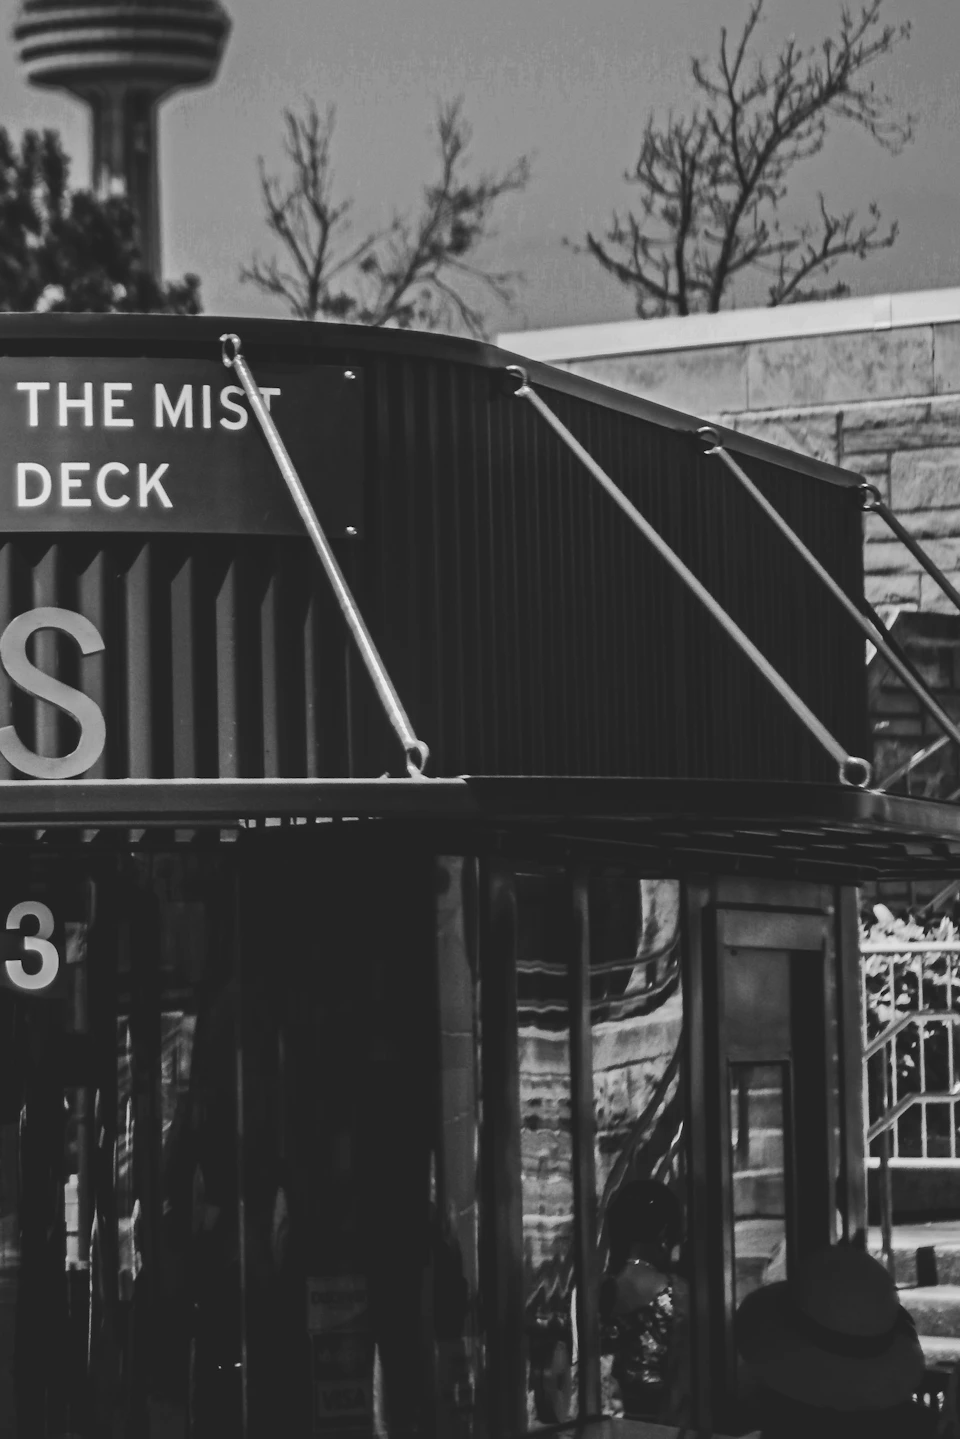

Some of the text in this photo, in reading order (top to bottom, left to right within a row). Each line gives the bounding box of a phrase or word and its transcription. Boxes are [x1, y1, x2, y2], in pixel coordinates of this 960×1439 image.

[16, 382, 134, 427] THE
[154, 383, 281, 431] MIST
[17, 461, 173, 508] DECK
[5, 901, 60, 990] 3
